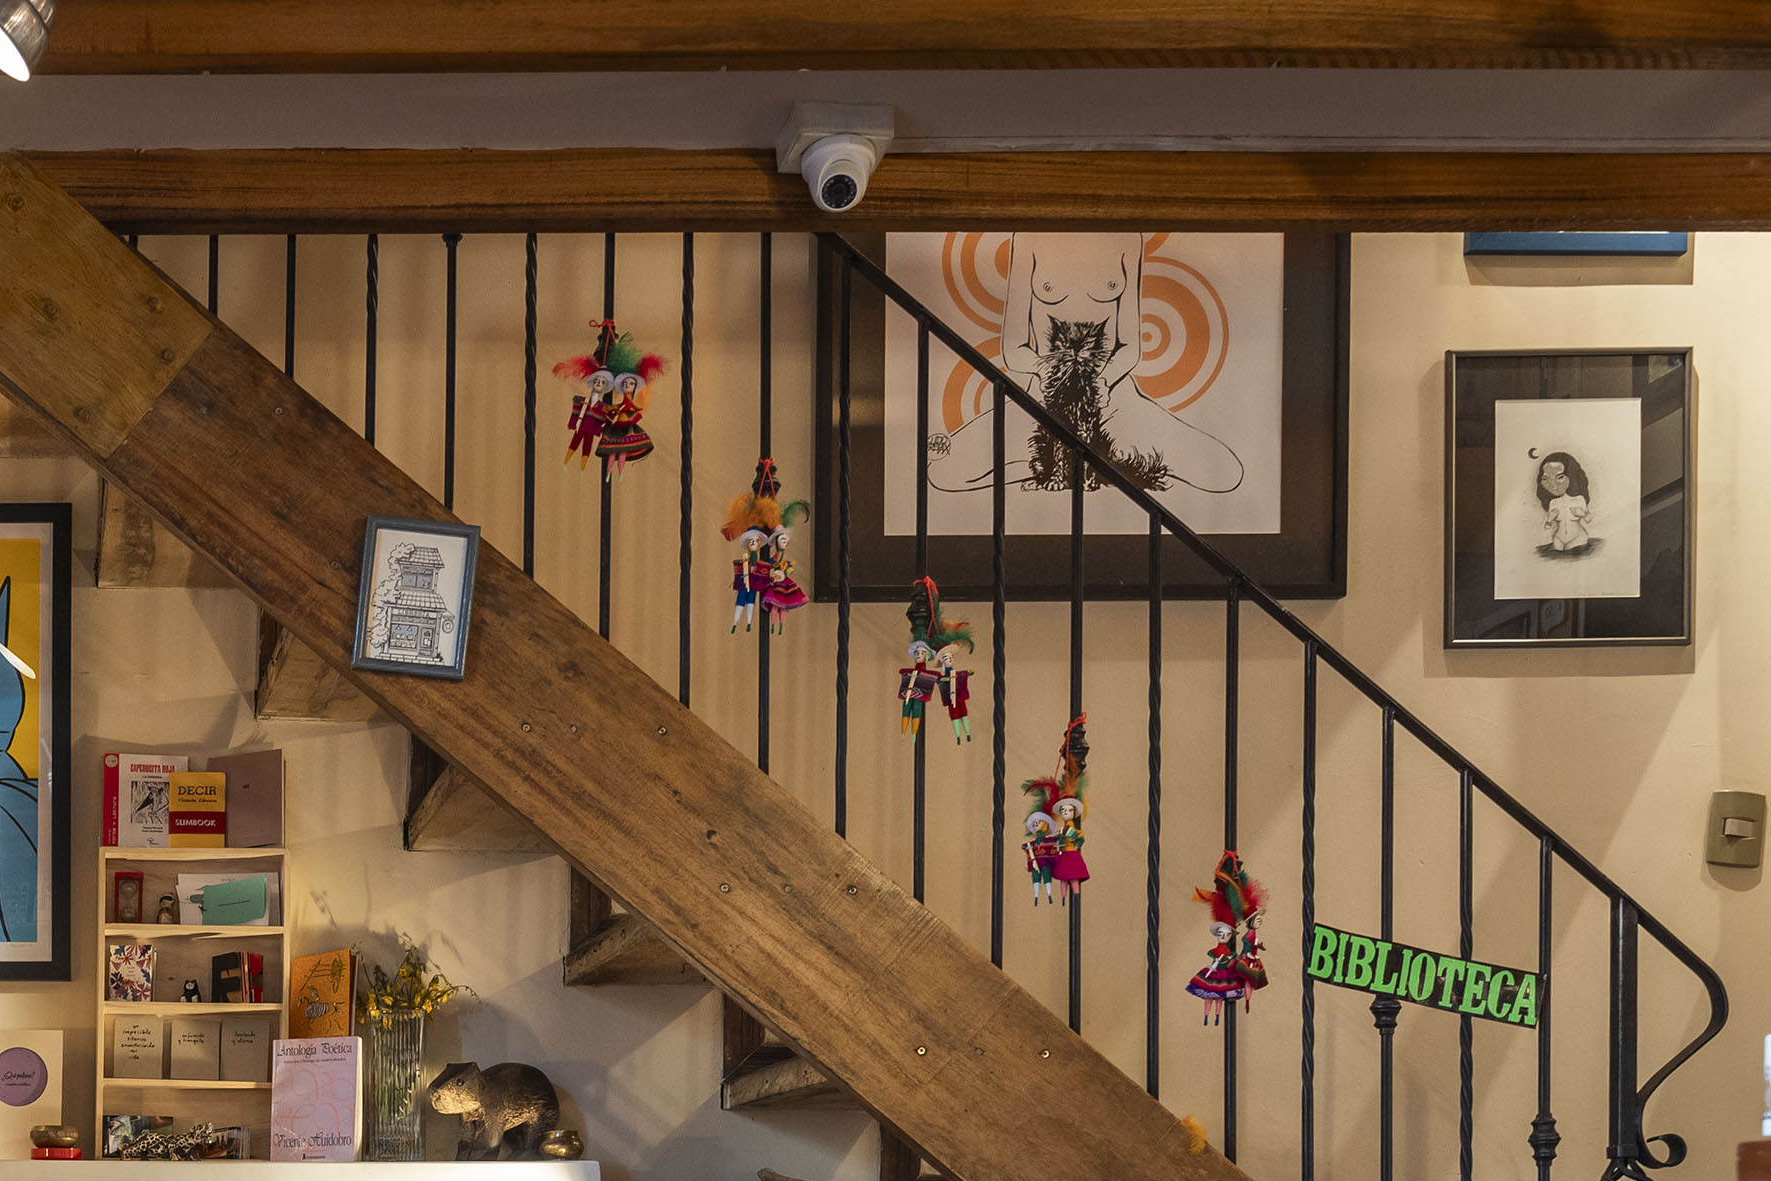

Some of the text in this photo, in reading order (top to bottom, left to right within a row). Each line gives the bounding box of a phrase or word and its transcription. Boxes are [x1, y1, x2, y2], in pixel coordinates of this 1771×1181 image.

[177, 785, 217, 796] DECIR
[175, 819, 217, 827] SLIMBOOK
[1307, 925, 1538, 1026] BIBLIOTECA
[277, 1042, 317, 1059] Antología
[273, 1131, 352, 1149] Vicente Huidobro
